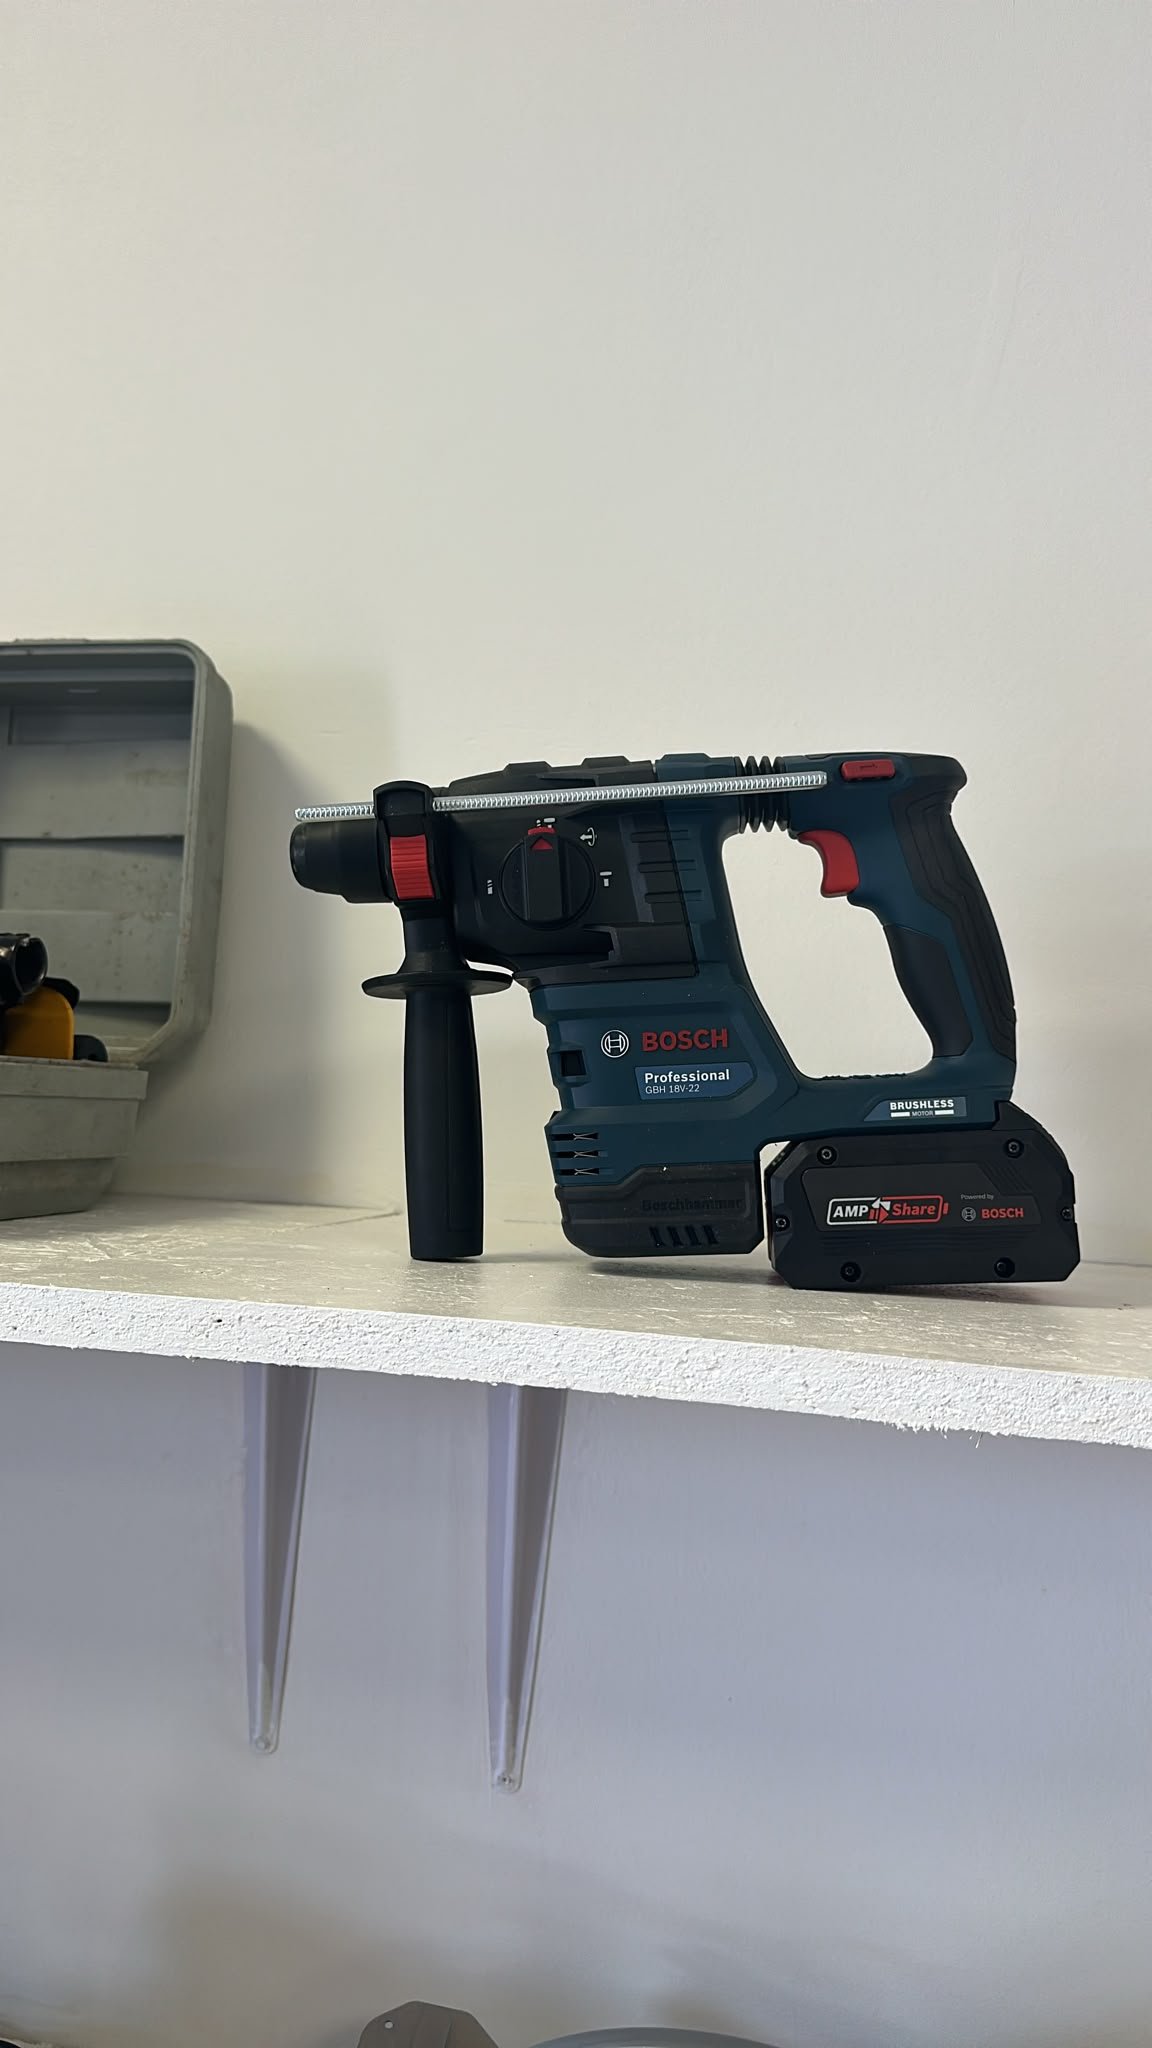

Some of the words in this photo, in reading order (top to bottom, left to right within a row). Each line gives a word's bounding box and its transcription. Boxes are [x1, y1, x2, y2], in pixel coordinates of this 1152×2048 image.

[642, 1028, 728, 1052] BOSCH
[644, 1069, 730, 1084] Professional
[645, 1086, 666, 1094] GBH
[669, 1084, 700, 1093] 18V-22
[890, 1099, 954, 1111] BRUSHLESS
[987, 1193, 994, 1202] by
[833, 1204, 869, 1218] AMP
[892, 1202, 937, 1217] Share
[981, 1208, 1025, 1219] BOSCH
